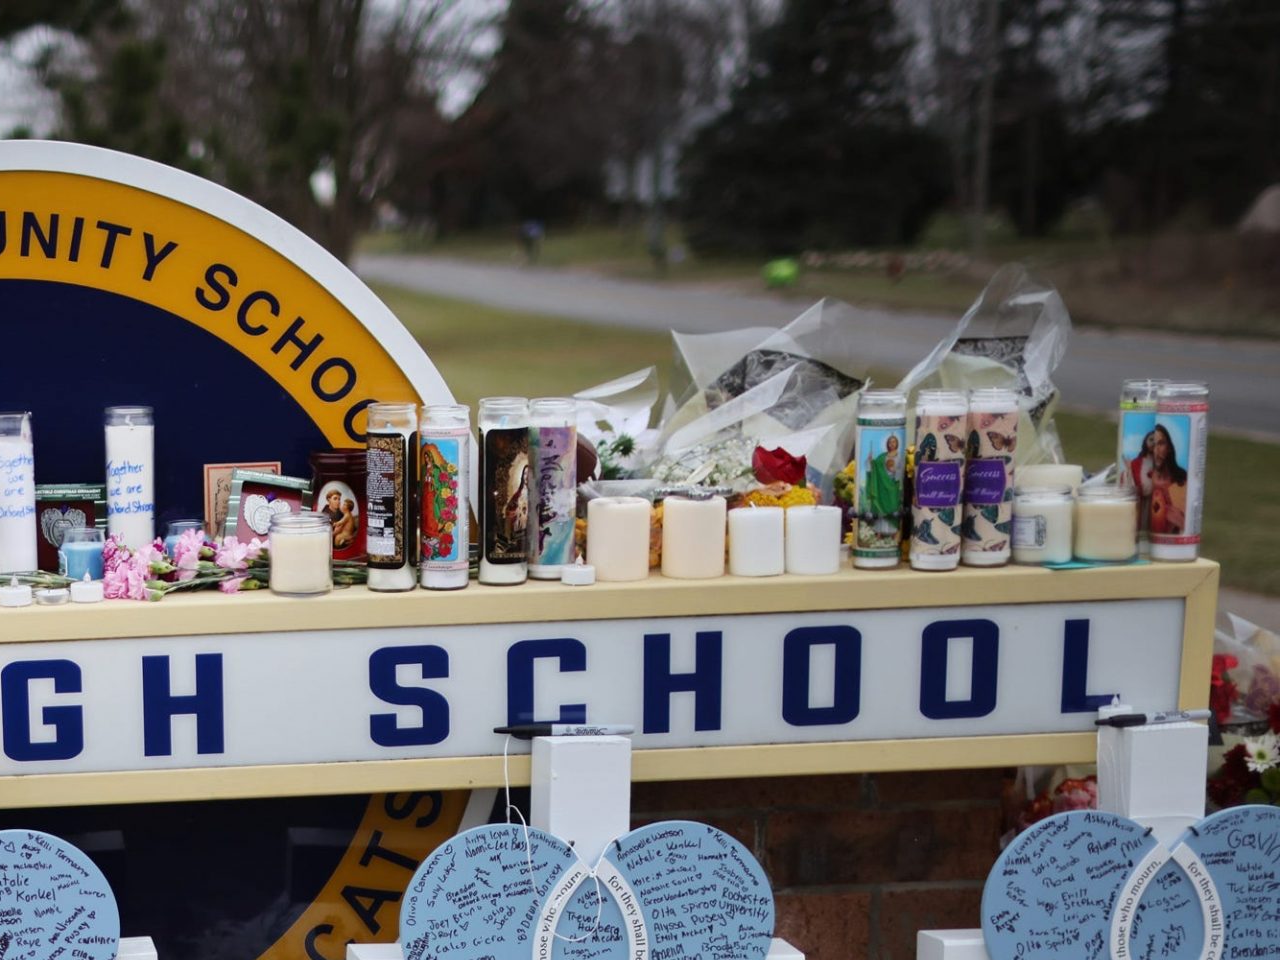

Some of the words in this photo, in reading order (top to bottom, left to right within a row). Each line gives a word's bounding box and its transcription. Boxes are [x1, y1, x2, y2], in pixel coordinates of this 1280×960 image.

[194, 263, 370, 443] SCHOO
[368, 617, 1121, 747] SCHOOL
[1187, 861, 1202, 878] for
[1199, 878, 1215, 902] they
[607, 875, 624, 892] for
[620, 891, 638, 917] they
[631, 919, 646, 946] shall
[1118, 898, 1135, 924] who
[1209, 904, 1221, 934] shall
[1116, 925, 1126, 959] those
[1210, 934, 1221, 948] be
